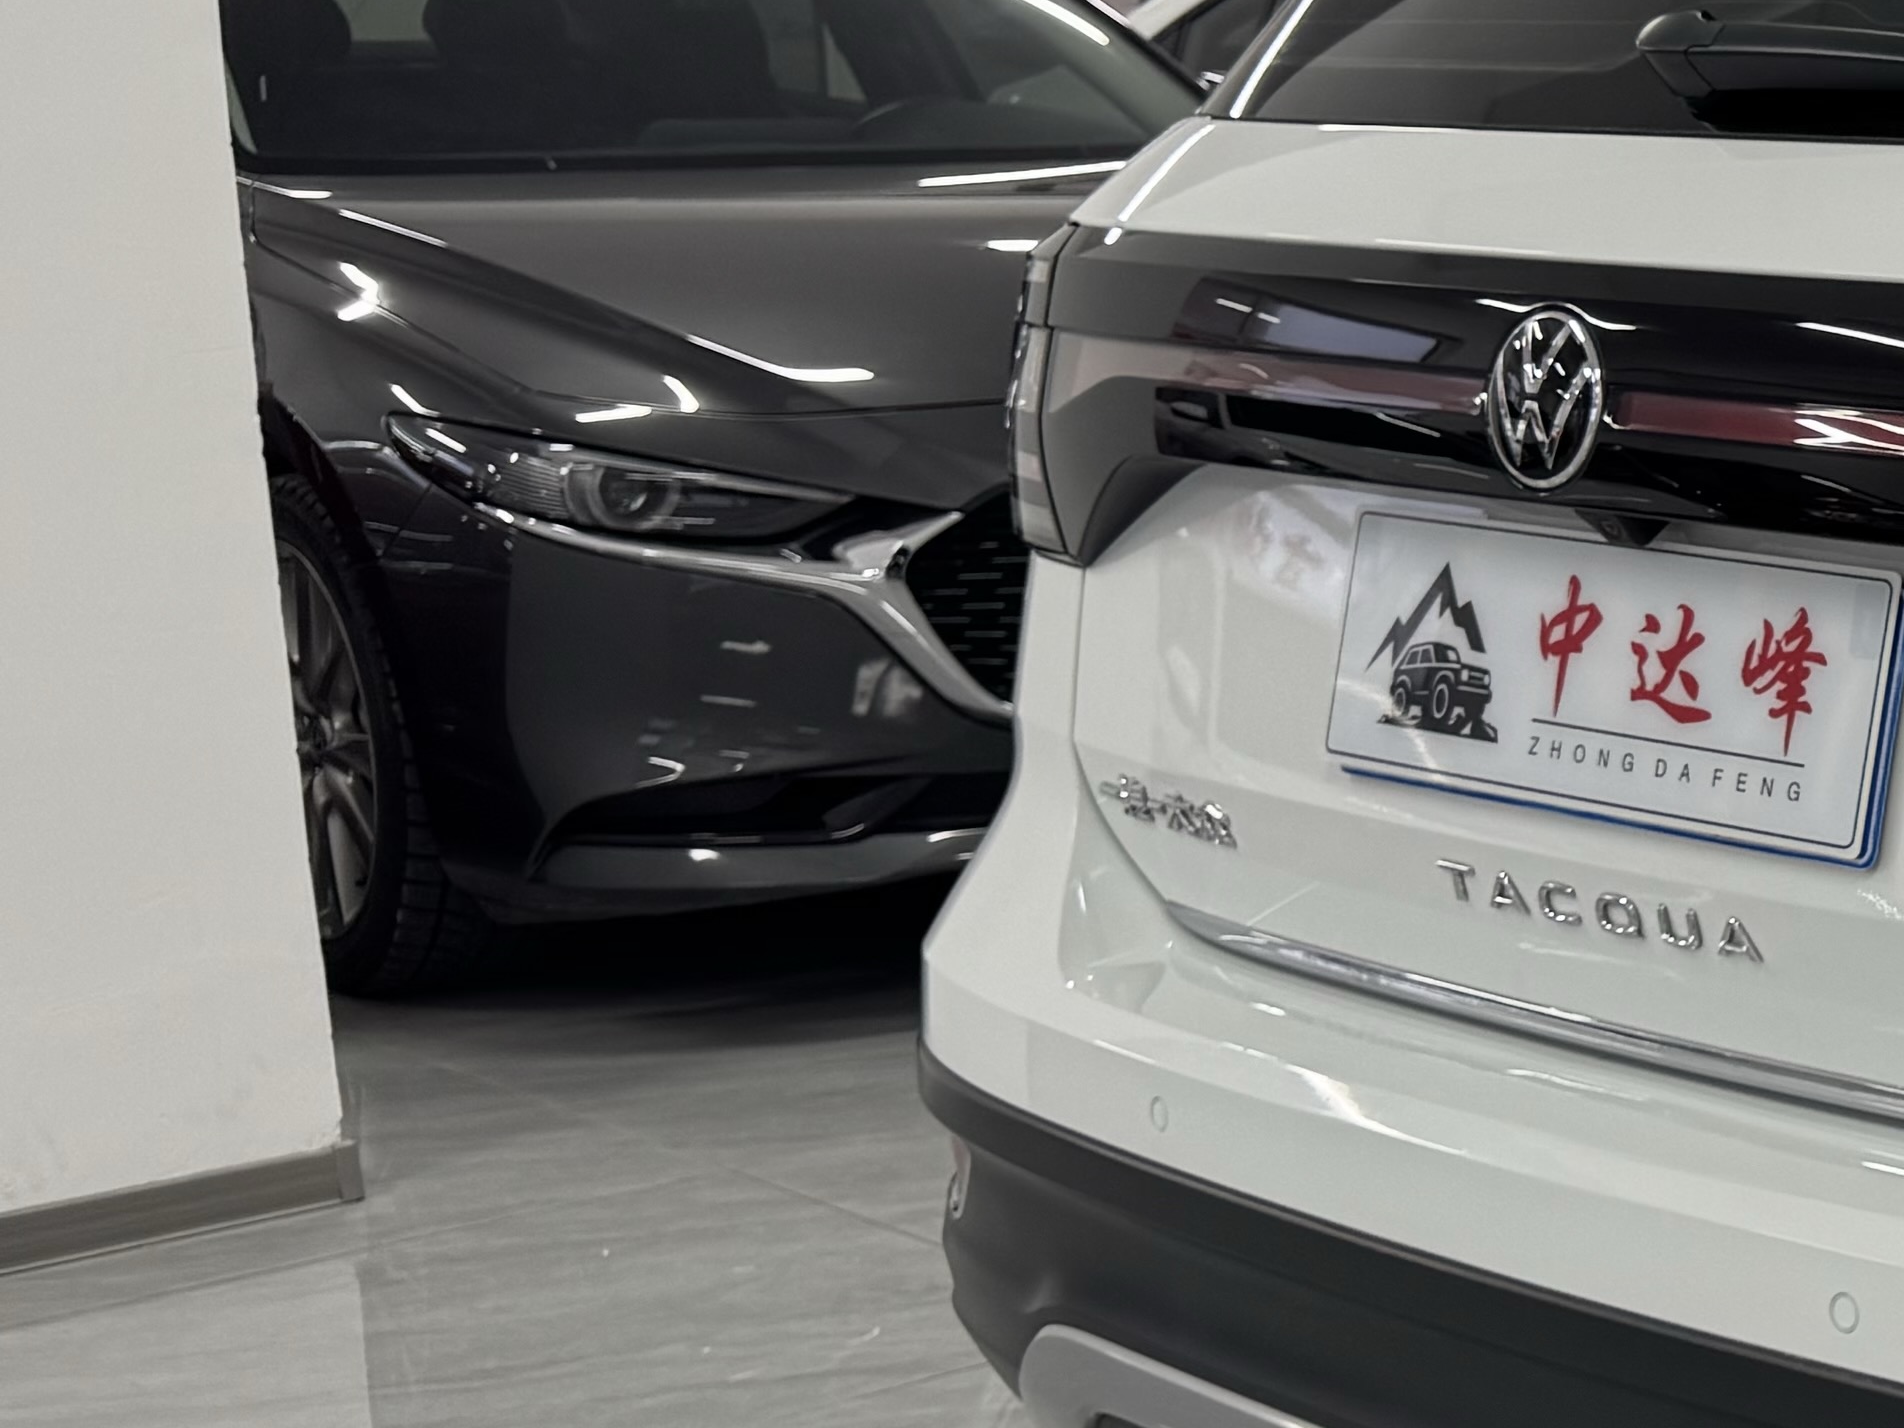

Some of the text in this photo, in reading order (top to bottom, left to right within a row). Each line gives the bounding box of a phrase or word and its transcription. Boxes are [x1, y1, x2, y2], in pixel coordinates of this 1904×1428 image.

[1539, 574, 1828, 757] 中达峰
[1527, 735, 1802, 802] ZHONG DA FENG
[1434, 858, 1765, 964] TACQUA
